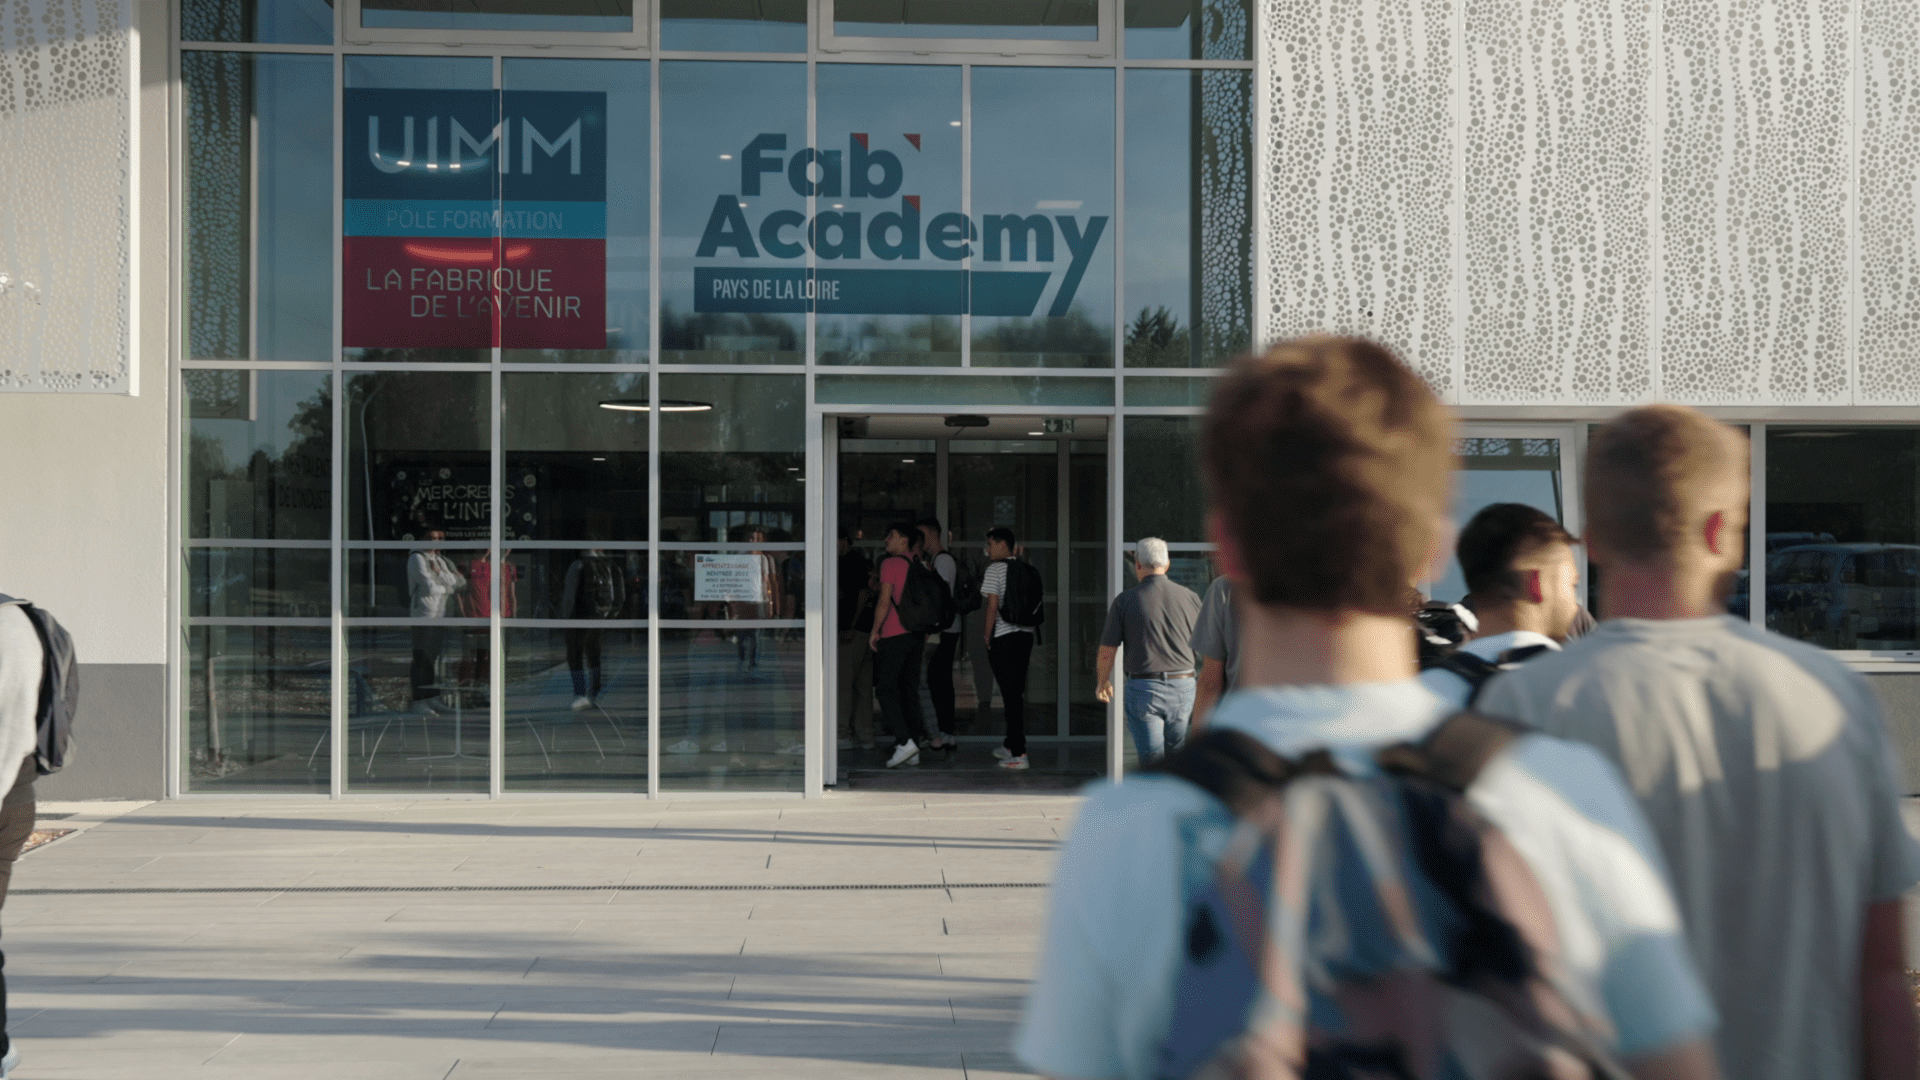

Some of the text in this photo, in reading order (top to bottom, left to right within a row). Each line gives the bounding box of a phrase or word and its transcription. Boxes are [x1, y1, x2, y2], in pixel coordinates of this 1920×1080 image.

[368, 115, 581, 174] UIMM
[443, 210, 563, 229] FORMATION
[695, 194, 1109, 316] Academy
[367, 268, 553, 294] LA FABRIQUE
[713, 278, 840, 300] PAYS DE LA LOIRE
[411, 295, 581, 318] DE L'AVENIR
[417, 485, 515, 501] MERCRES
